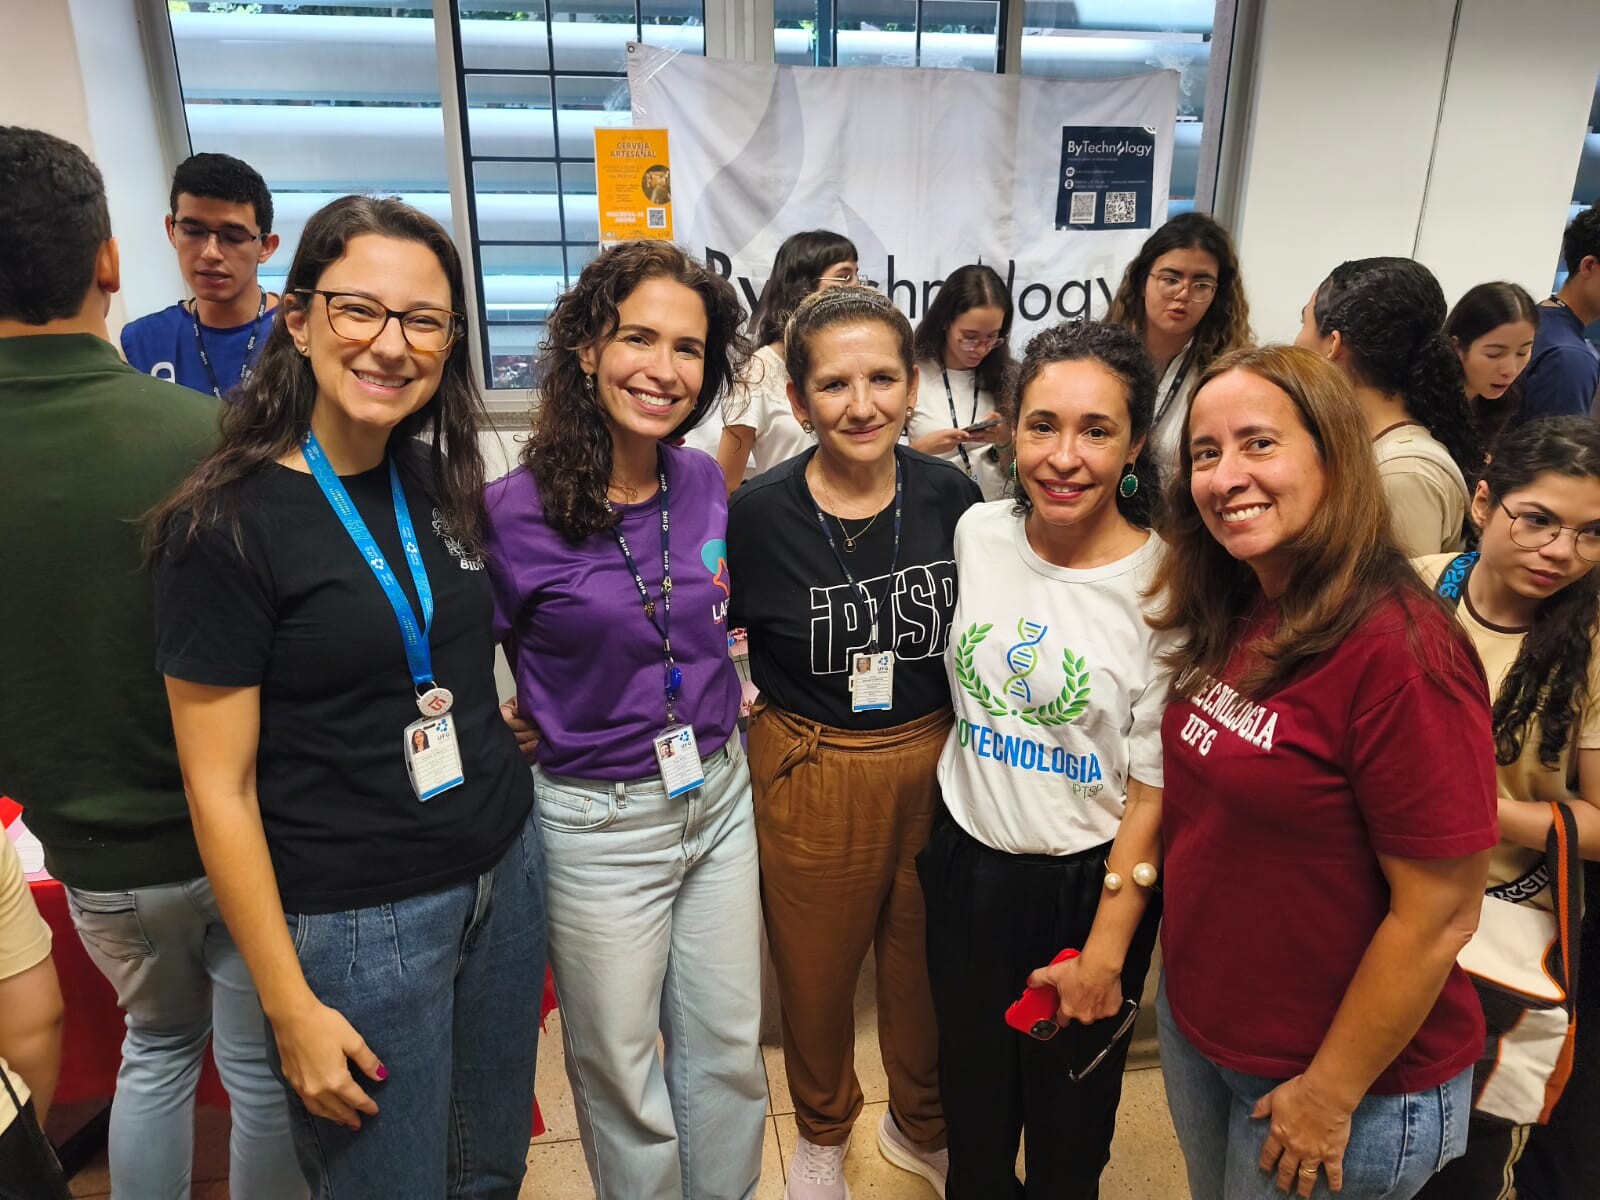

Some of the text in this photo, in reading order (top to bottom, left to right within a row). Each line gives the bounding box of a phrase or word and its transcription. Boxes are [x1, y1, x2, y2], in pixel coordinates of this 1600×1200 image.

[617, 142, 649, 150] CERVEJA
[1067, 140, 1152, 156] ByTechnology
[610, 150, 656, 158] ARTESANAL
[1181, 713, 1218, 755] UFG
